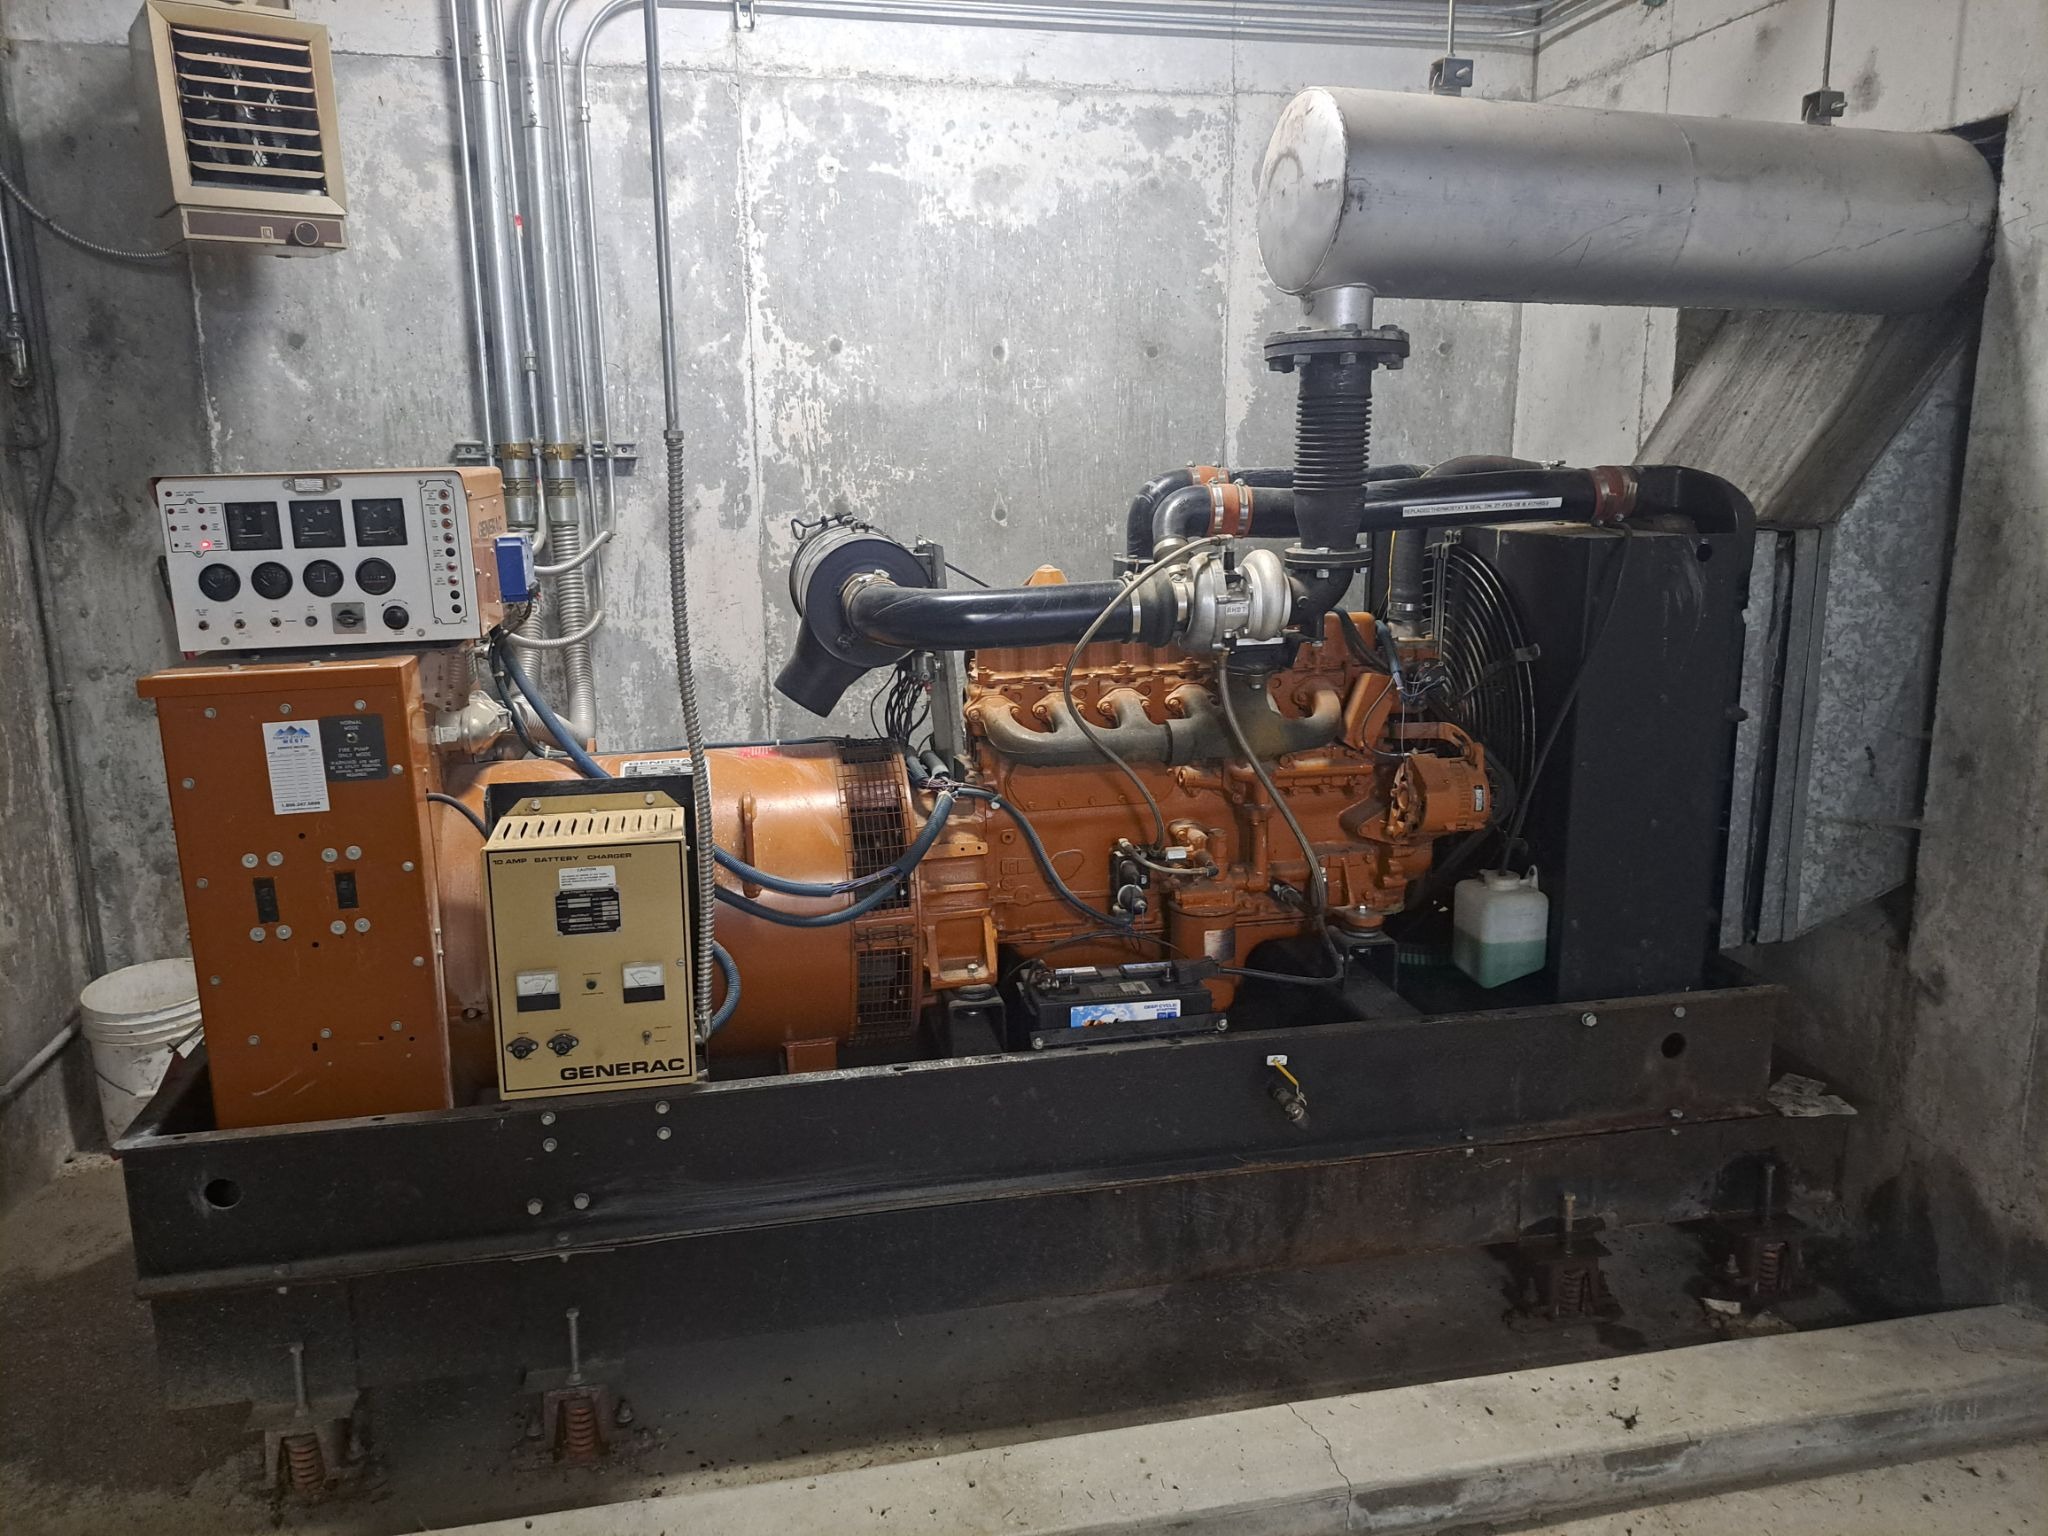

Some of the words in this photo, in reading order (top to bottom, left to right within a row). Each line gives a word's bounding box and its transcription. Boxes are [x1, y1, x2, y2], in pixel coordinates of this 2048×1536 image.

[534, 855, 579, 863] BATTERY
[587, 852, 632, 860] CHARGER
[560, 1058, 685, 1081] GENERAC
